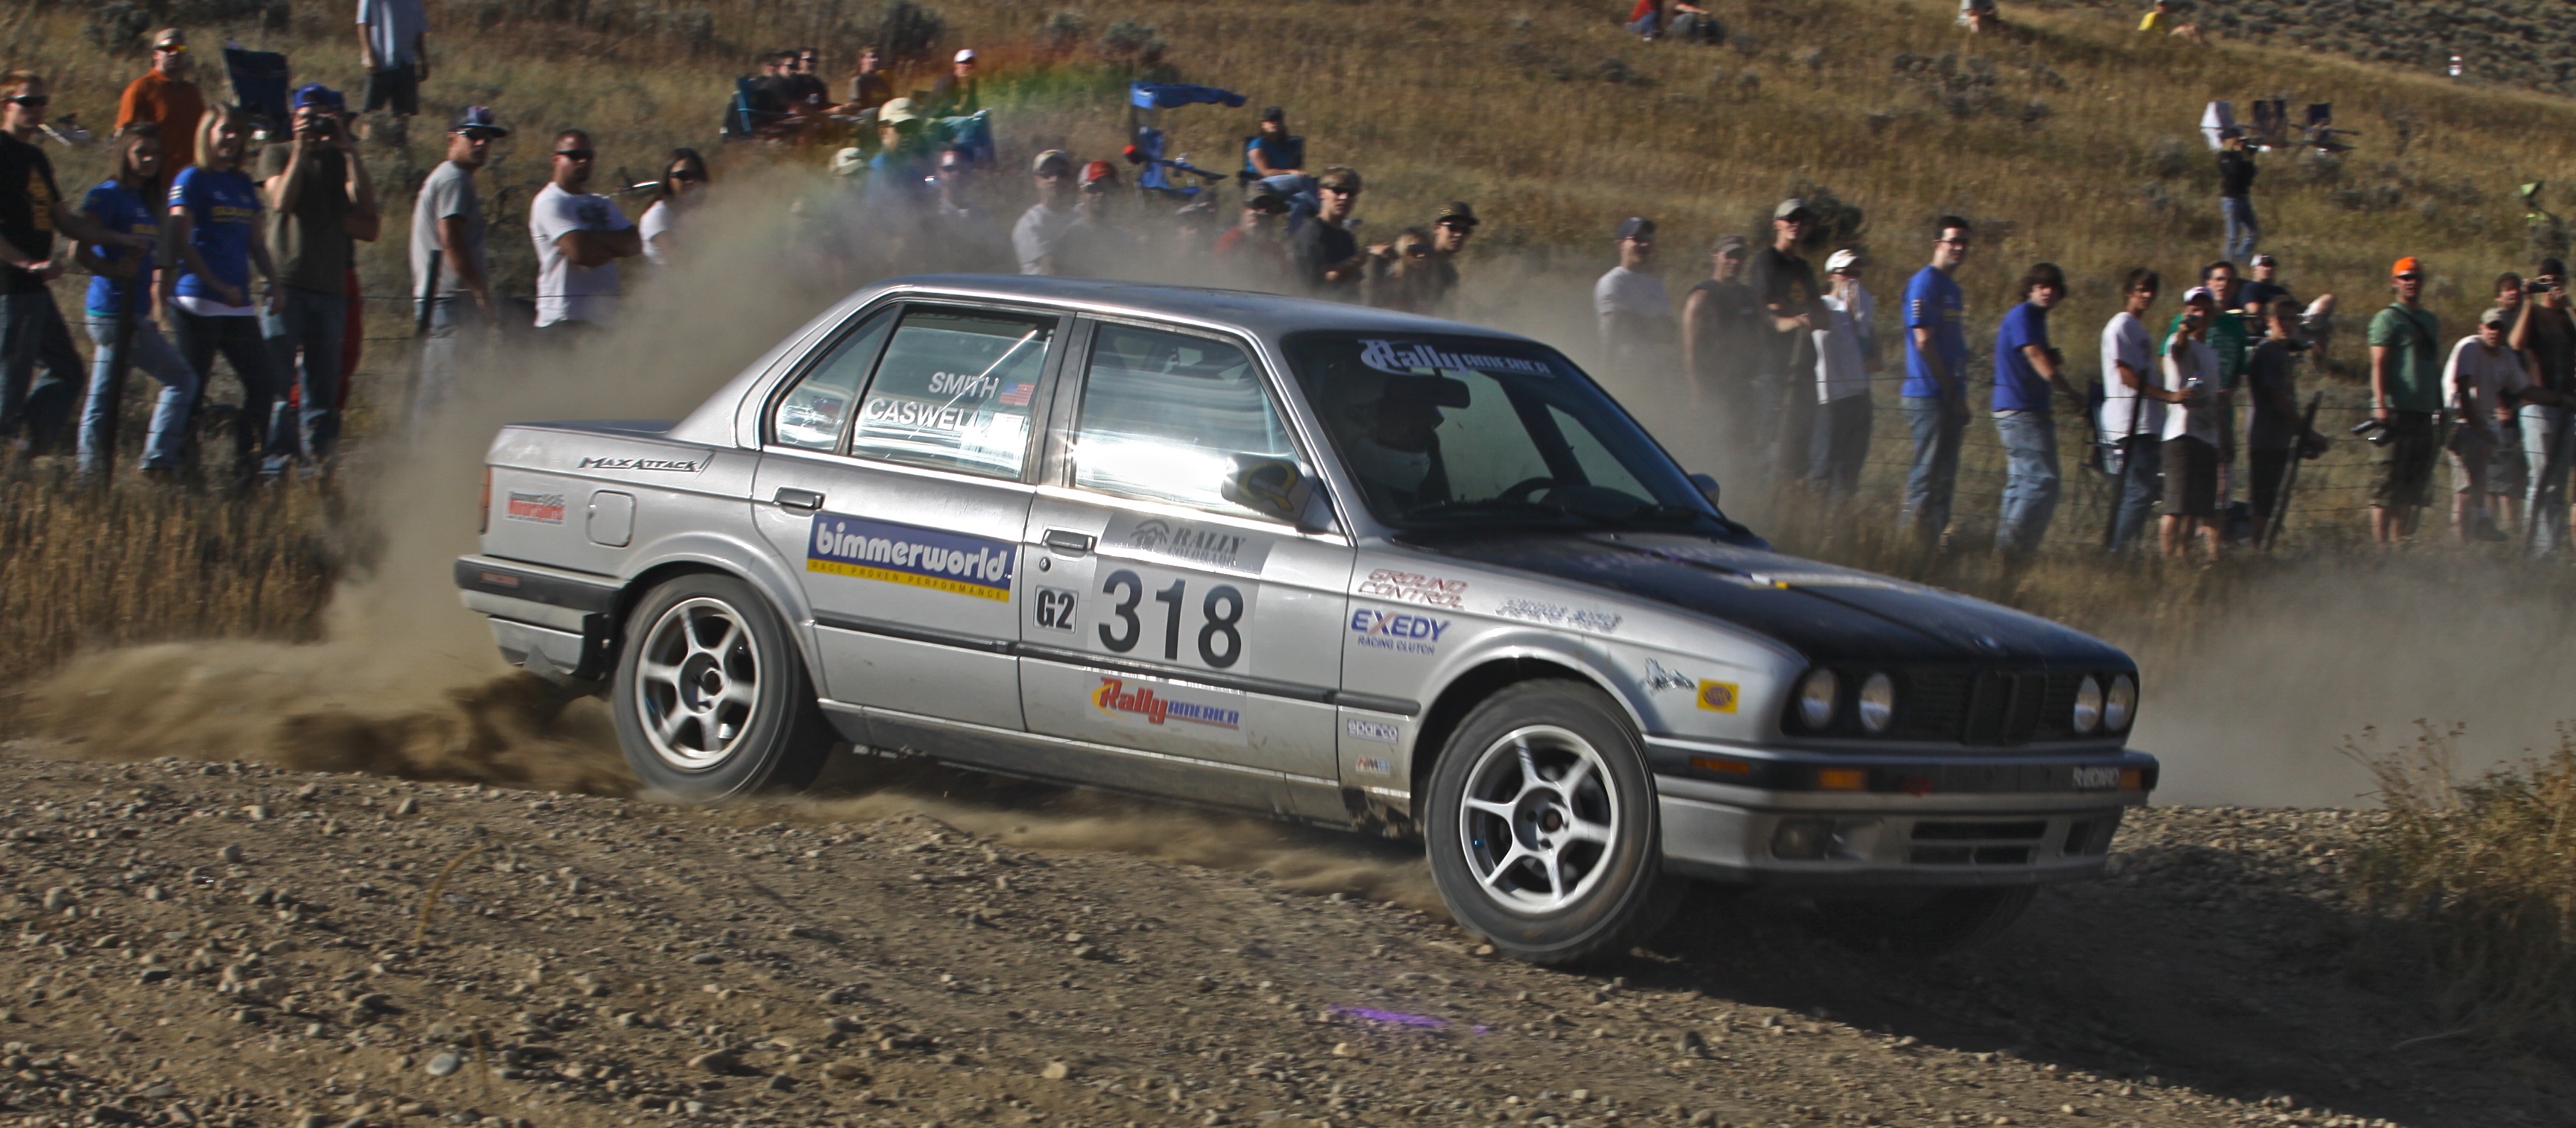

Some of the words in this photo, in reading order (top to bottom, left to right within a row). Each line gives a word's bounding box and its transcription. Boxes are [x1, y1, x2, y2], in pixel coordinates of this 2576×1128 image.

[1357, 339, 1468, 374] Rally
[929, 371, 1000, 399] SMITH
[815, 522, 1007, 582] bimmerworld
[1172, 526, 1246, 555] RALLY
[812, 561, 843, 573] RACE
[851, 567, 899, 582] PROVEN
[908, 576, 1003, 600] PERFORMANCE
[1358, 581, 1466, 611] CONTROL
[1368, 568, 1469, 594] GROUND
[1036, 590, 1075, 629] G2
[1099, 569, 1244, 669] 318
[1351, 608, 1450, 643] EXEDY
[1357, 635, 1395, 650] RACING
[1396, 641, 1436, 656] CLUTCH
[1098, 676, 1168, 725] Rally
